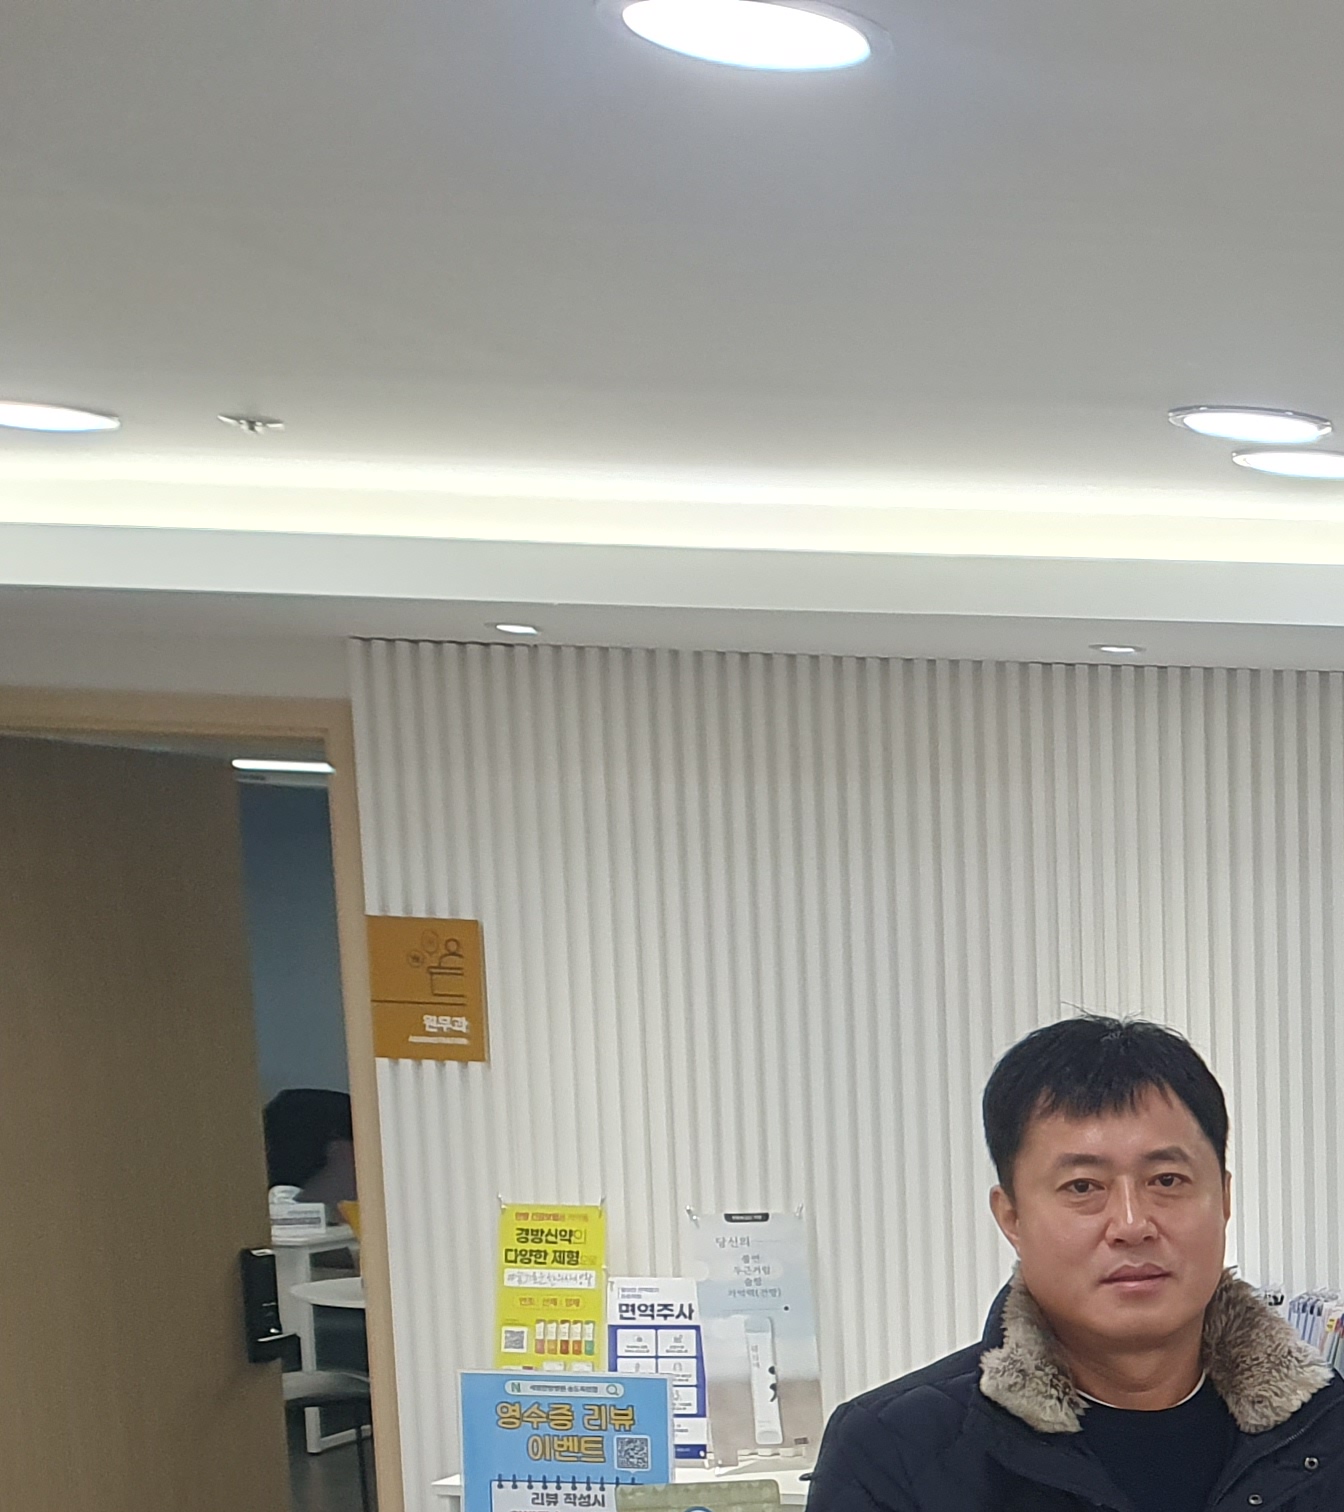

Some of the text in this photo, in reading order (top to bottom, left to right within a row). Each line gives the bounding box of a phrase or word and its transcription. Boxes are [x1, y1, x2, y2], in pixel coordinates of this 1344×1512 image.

[715, 1236, 750, 1249] 당신의
[504, 1248, 548, 1266] 다양한
[618, 1302, 695, 1321] 면역주사
[496, 1401, 635, 1432] 영수증 리뷰
[527, 1434, 606, 1463] 이벤트
[531, 1492, 558, 1506] 리뷰
